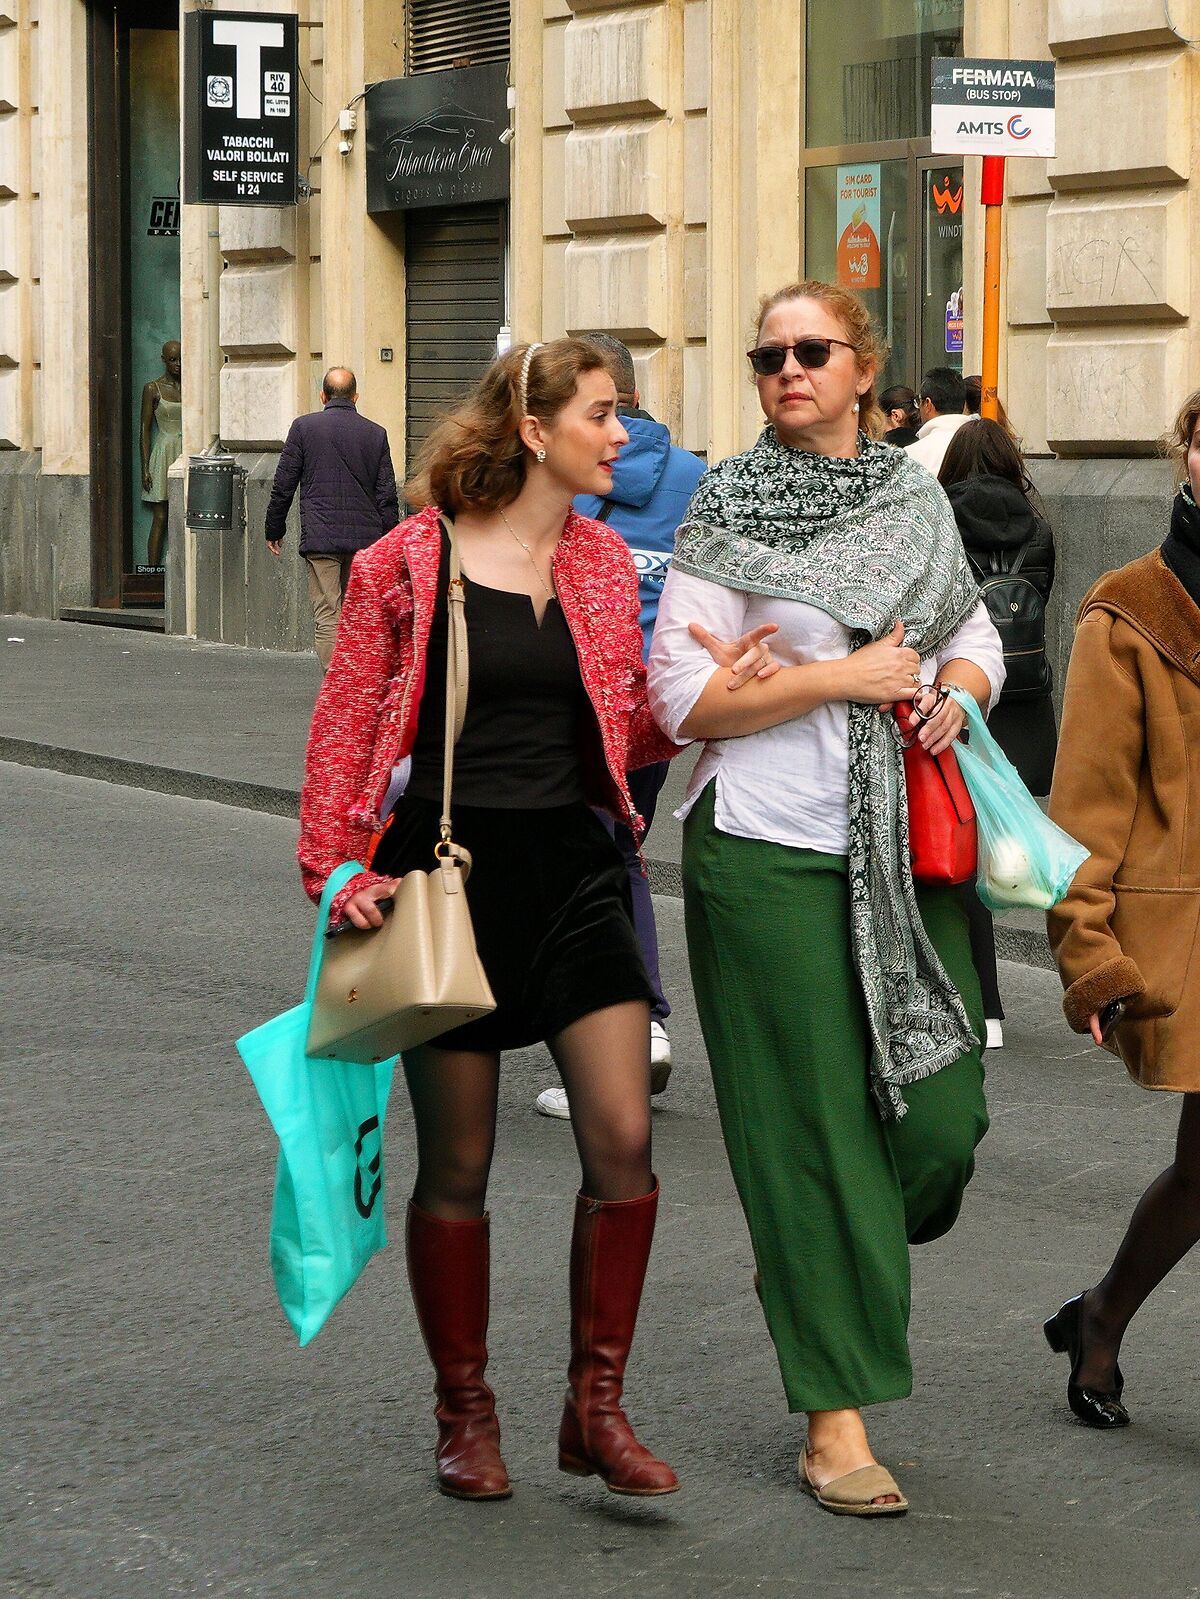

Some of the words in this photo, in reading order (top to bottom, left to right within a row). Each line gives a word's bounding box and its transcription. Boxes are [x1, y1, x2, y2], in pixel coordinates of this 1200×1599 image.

[213, 20, 284, 119] T
[270, 74, 286, 82] RIV.
[952, 68, 1036, 88] FERMATA
[271, 82, 285, 91] 40
[966, 89, 990, 100] (BUS
[992, 90, 1021, 102] STOP)
[957, 121, 1004, 135] AMTS
[223, 136, 274, 149] TABACCHI
[207, 150, 245, 162] VALORI
[247, 151, 289, 163] BOLLATI
[213, 170, 238, 182] SELF
[240, 172, 284, 183] SERVICE
[857, 174, 872, 184] CARD
[237, 184, 246, 194] H
[247, 185, 260, 195] 24
[840, 189, 853, 199] FOR
[853, 187, 878, 198] TOURIST
[137, 565, 155, 573] Shop
